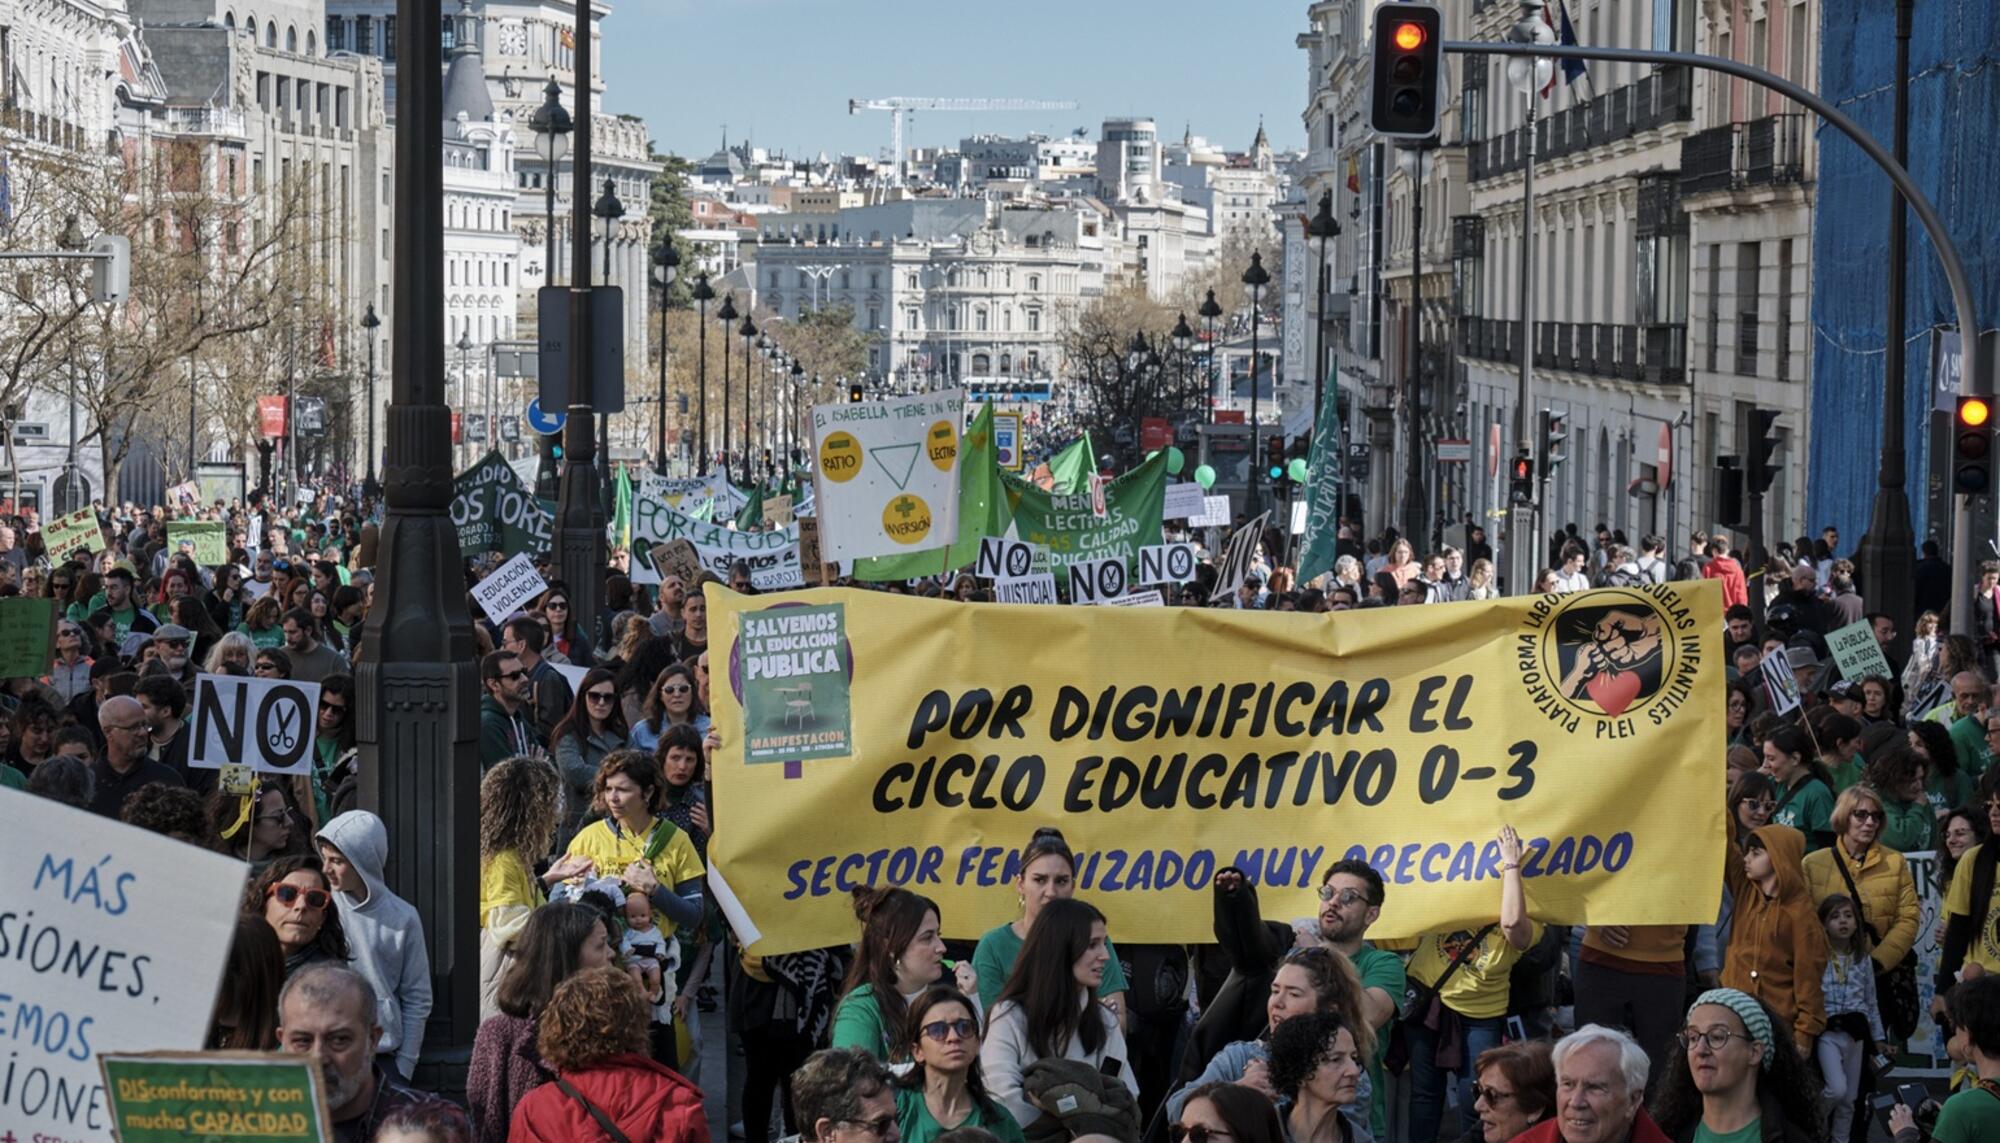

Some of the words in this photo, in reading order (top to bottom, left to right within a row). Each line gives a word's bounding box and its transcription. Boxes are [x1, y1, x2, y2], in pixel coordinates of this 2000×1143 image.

[832, 405, 888, 423] ISABELLA
[893, 403, 926, 420] TIENE
[823, 454, 856, 471] RATIO
[1051, 490, 1116, 511] MENS
[637, 498, 686, 541] POR
[886, 515, 930, 535] INVERSIÓN
[978, 538, 1031, 577] NO
[1051, 540, 1134, 567] DUCATIVA
[1141, 545, 1193, 582] NO
[1070, 560, 1125, 603] NO
[744, 612, 838, 639] SALVEMOS
[746, 639, 766, 654] LA
[746, 649, 841, 680] PÚBLICA
[1517, 634, 1581, 734] PLATAFORMA
[1647, 635, 1702, 726] INFANTILES
[193, 679, 312, 768] NO
[906, 683, 1034, 750] POR
[1049, 677, 1391, 743] DIGNIFICAR
[1408, 674, 1474, 733] EL
[1595, 717, 1636, 740] PLEI
[872, 752, 1046, 813] CICLO
[1063, 748, 1397, 813] EDUCATIVO
[1417, 739, 1538, 805] 0-3
[33, 853, 136, 915] MÁS
[783, 845, 944, 900] SECTOR
[955, 844, 1216, 891] FEMIZADO
[1231, 844, 1325, 888] MUY
[1342, 831, 1634, 887] RECARZADO
[0, 910, 160, 1005] SIONES,
[2, 1052, 102, 1130] IONE
[117, 1078, 246, 1102] DISconformes
[251, 1087, 263, 1106] y
[267, 1087, 304, 1102] con
[126, 1109, 187, 1131] mucha
[189, 1110, 308, 1135] CAPACIDAD
